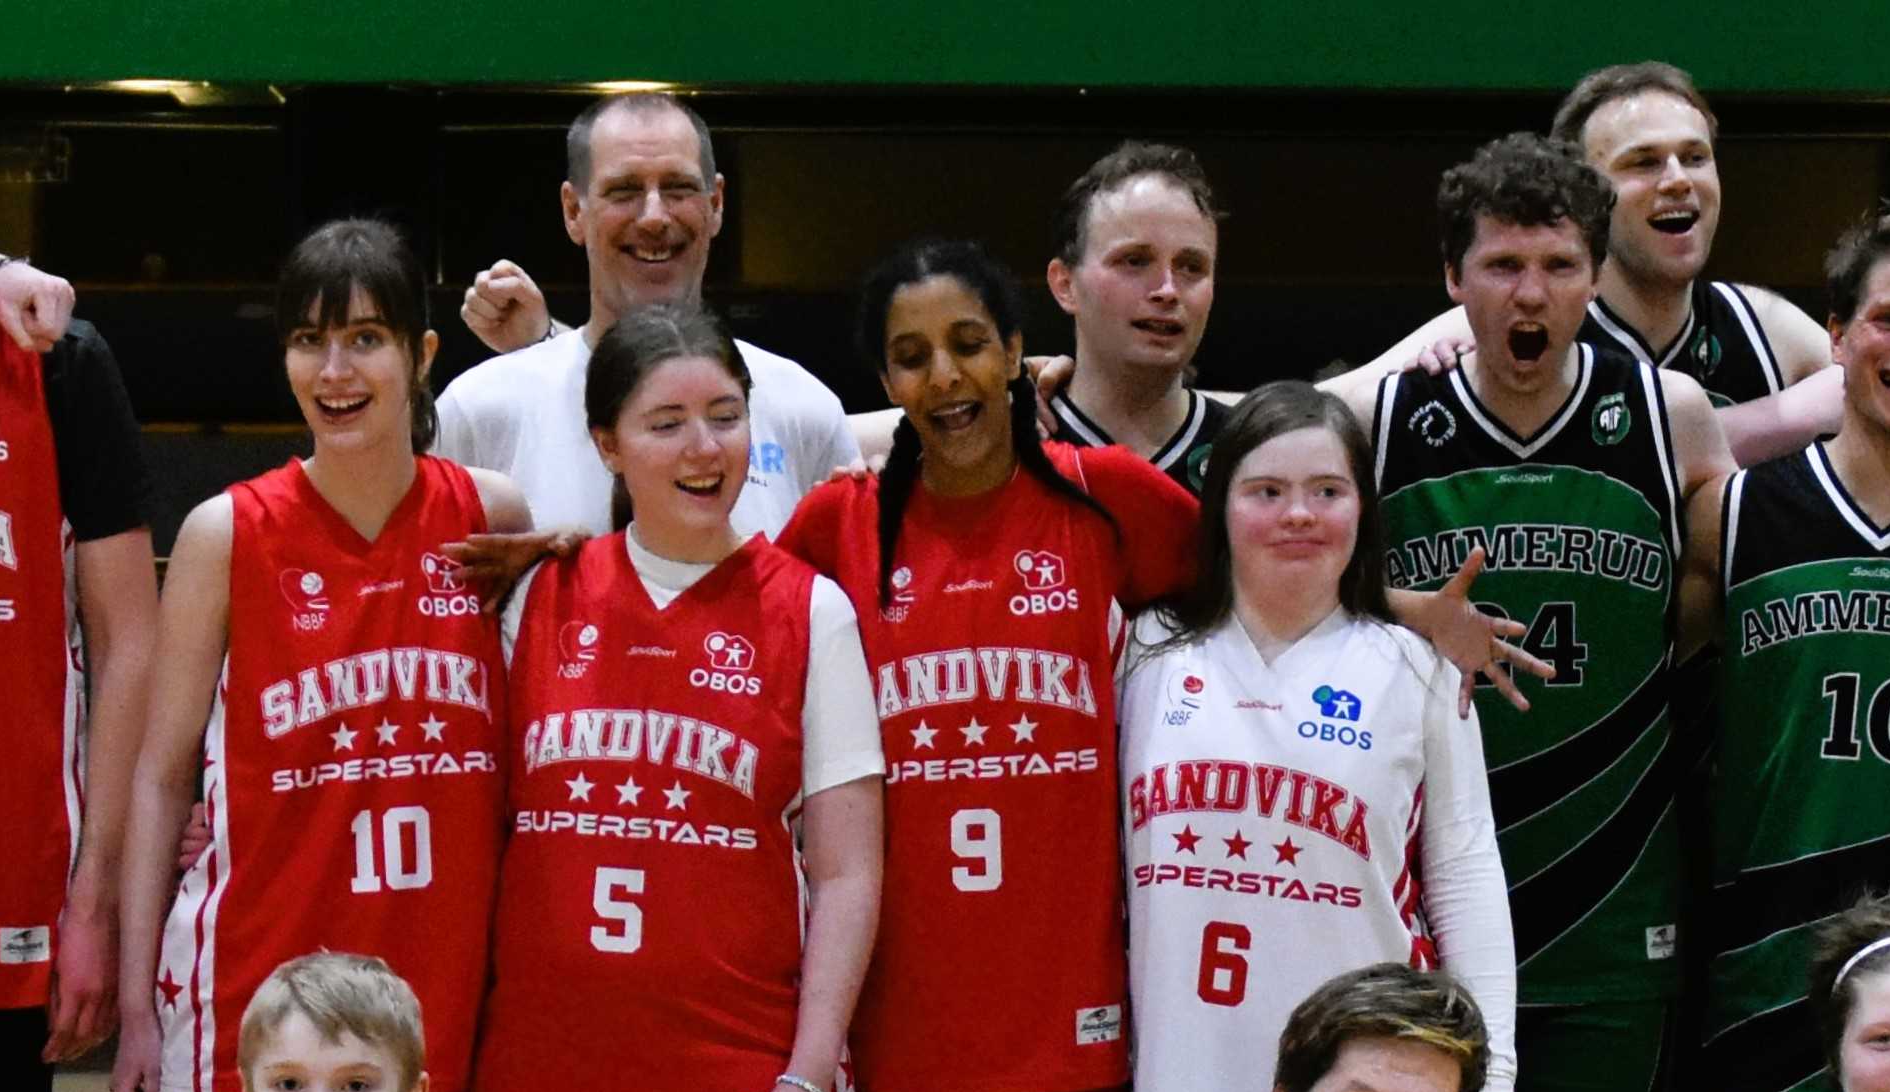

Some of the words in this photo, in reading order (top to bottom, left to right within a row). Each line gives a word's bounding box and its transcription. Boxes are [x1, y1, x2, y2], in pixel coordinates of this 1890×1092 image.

[1385, 523, 1664, 592] AMMERUD
[292, 613, 328, 632] NBBF
[418, 595, 480, 617] OBOS
[1009, 588, 1079, 616] OBOS
[260, 647, 492, 740] SANDVIK
[689, 668, 762, 696] OBOS
[877, 646, 1098, 722] ANDVIKA
[1162, 711, 1194, 727] NBBF
[1297, 721, 1373, 750] OBOS
[523, 708, 759, 801] SANDVIKA
[885, 748, 1099, 785] UPERSTARS
[516, 810, 758, 850] SUPERSTARS
[1129, 759, 1372, 862] SANDVIKA
[350, 805, 434, 894] 10
[950, 808, 1003, 892] 9
[589, 865, 645, 954] 5
[1197, 920, 1252, 1008] 6
